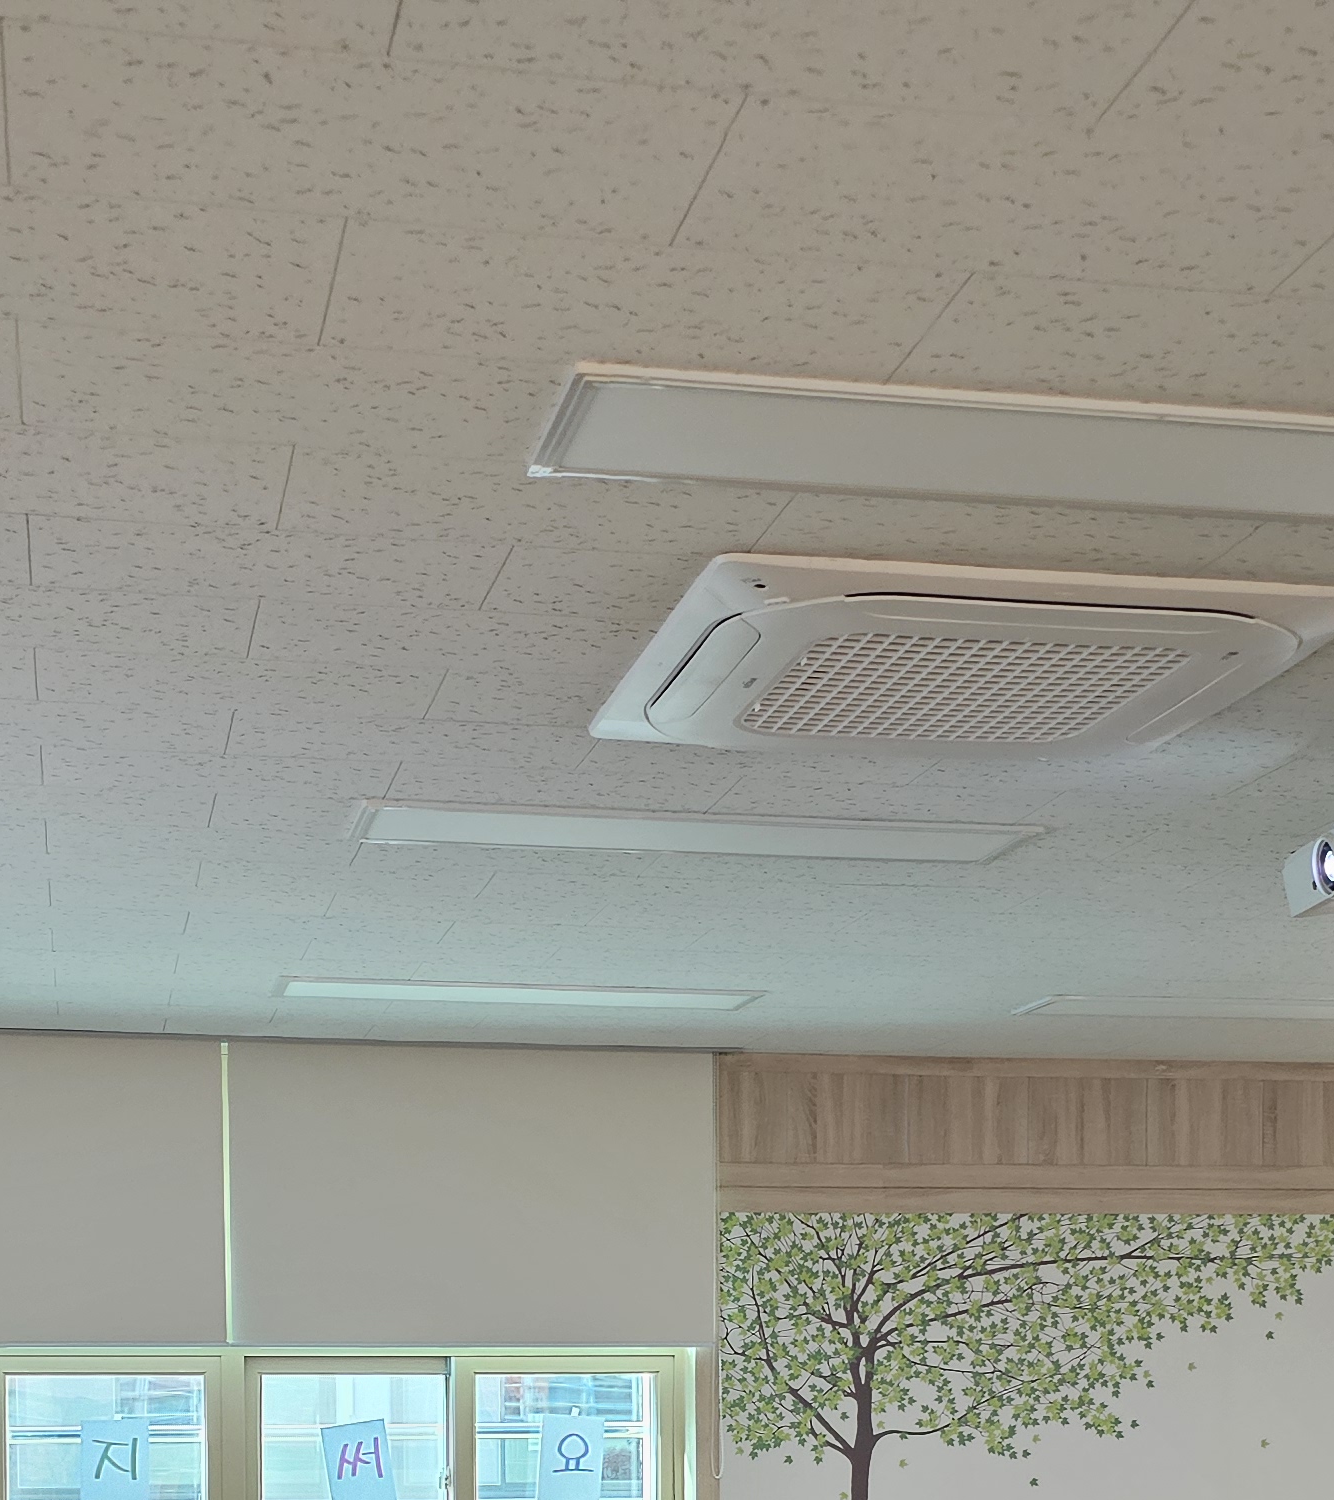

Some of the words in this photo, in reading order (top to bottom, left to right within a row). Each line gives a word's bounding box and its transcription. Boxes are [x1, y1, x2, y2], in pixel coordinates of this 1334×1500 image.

[92, 1437, 139, 1481] 지
[336, 1436, 384, 1480] 써
[551, 1433, 595, 1474] 요
